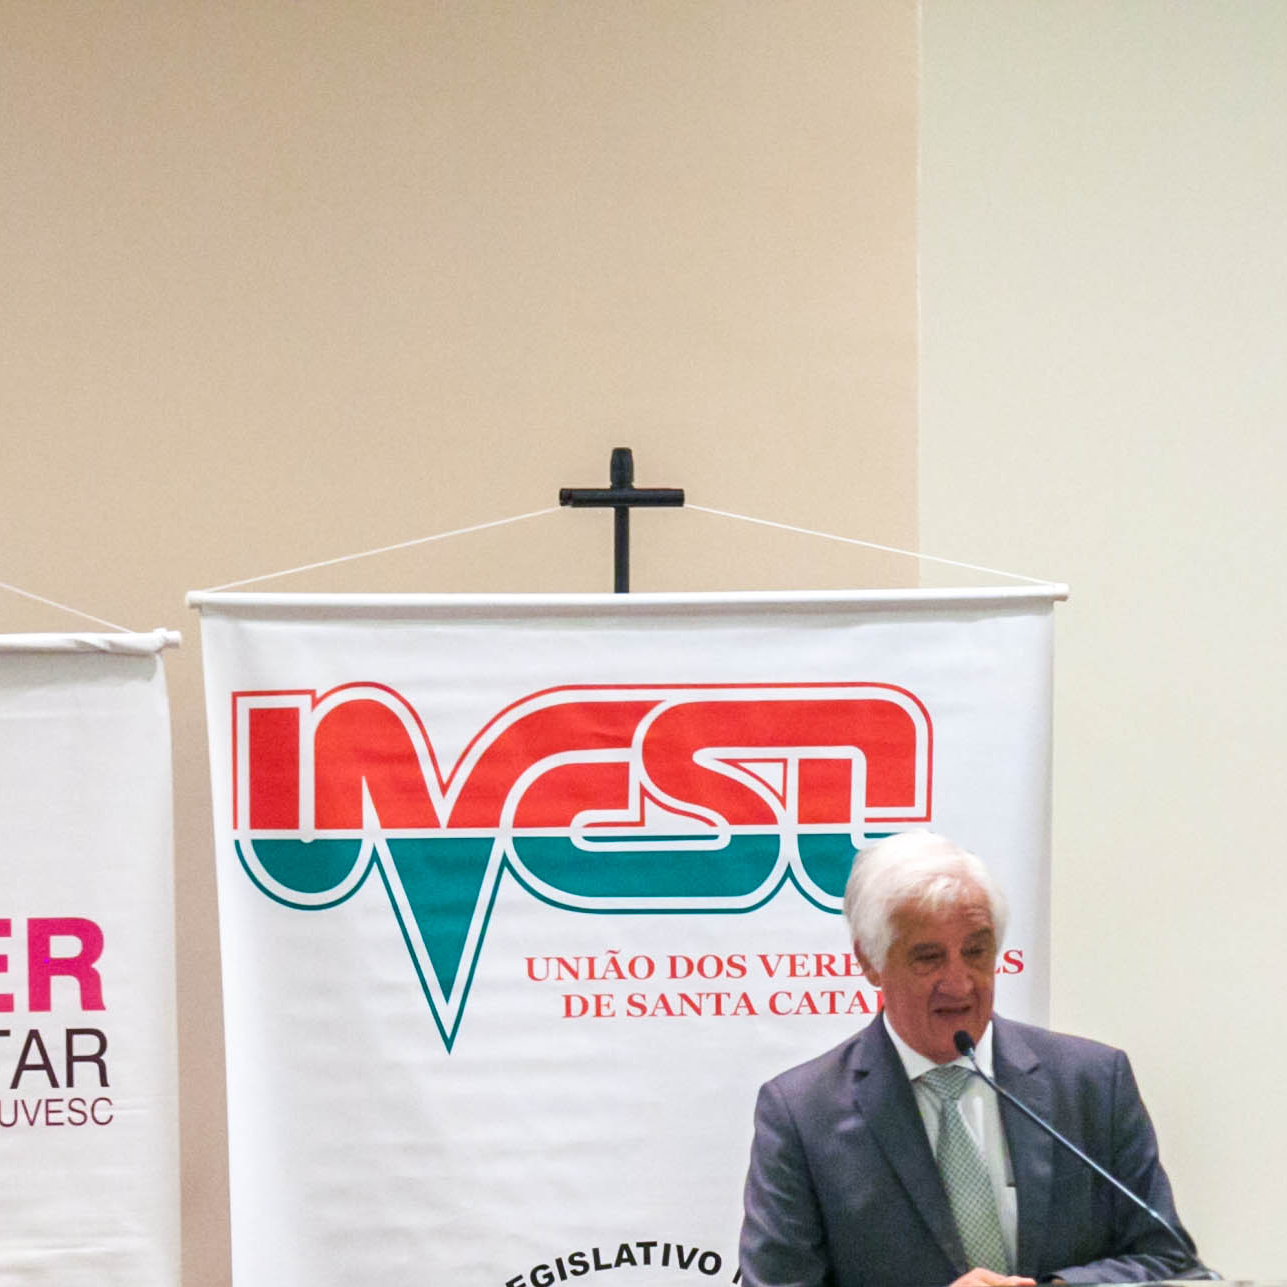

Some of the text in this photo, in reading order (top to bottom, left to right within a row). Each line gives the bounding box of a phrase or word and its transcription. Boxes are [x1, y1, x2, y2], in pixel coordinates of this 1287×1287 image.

[524, 949, 1025, 982] UNIÃO DOS VERES
[562, 993, 616, 1019] DE
[626, 992, 759, 1018] SANTA
